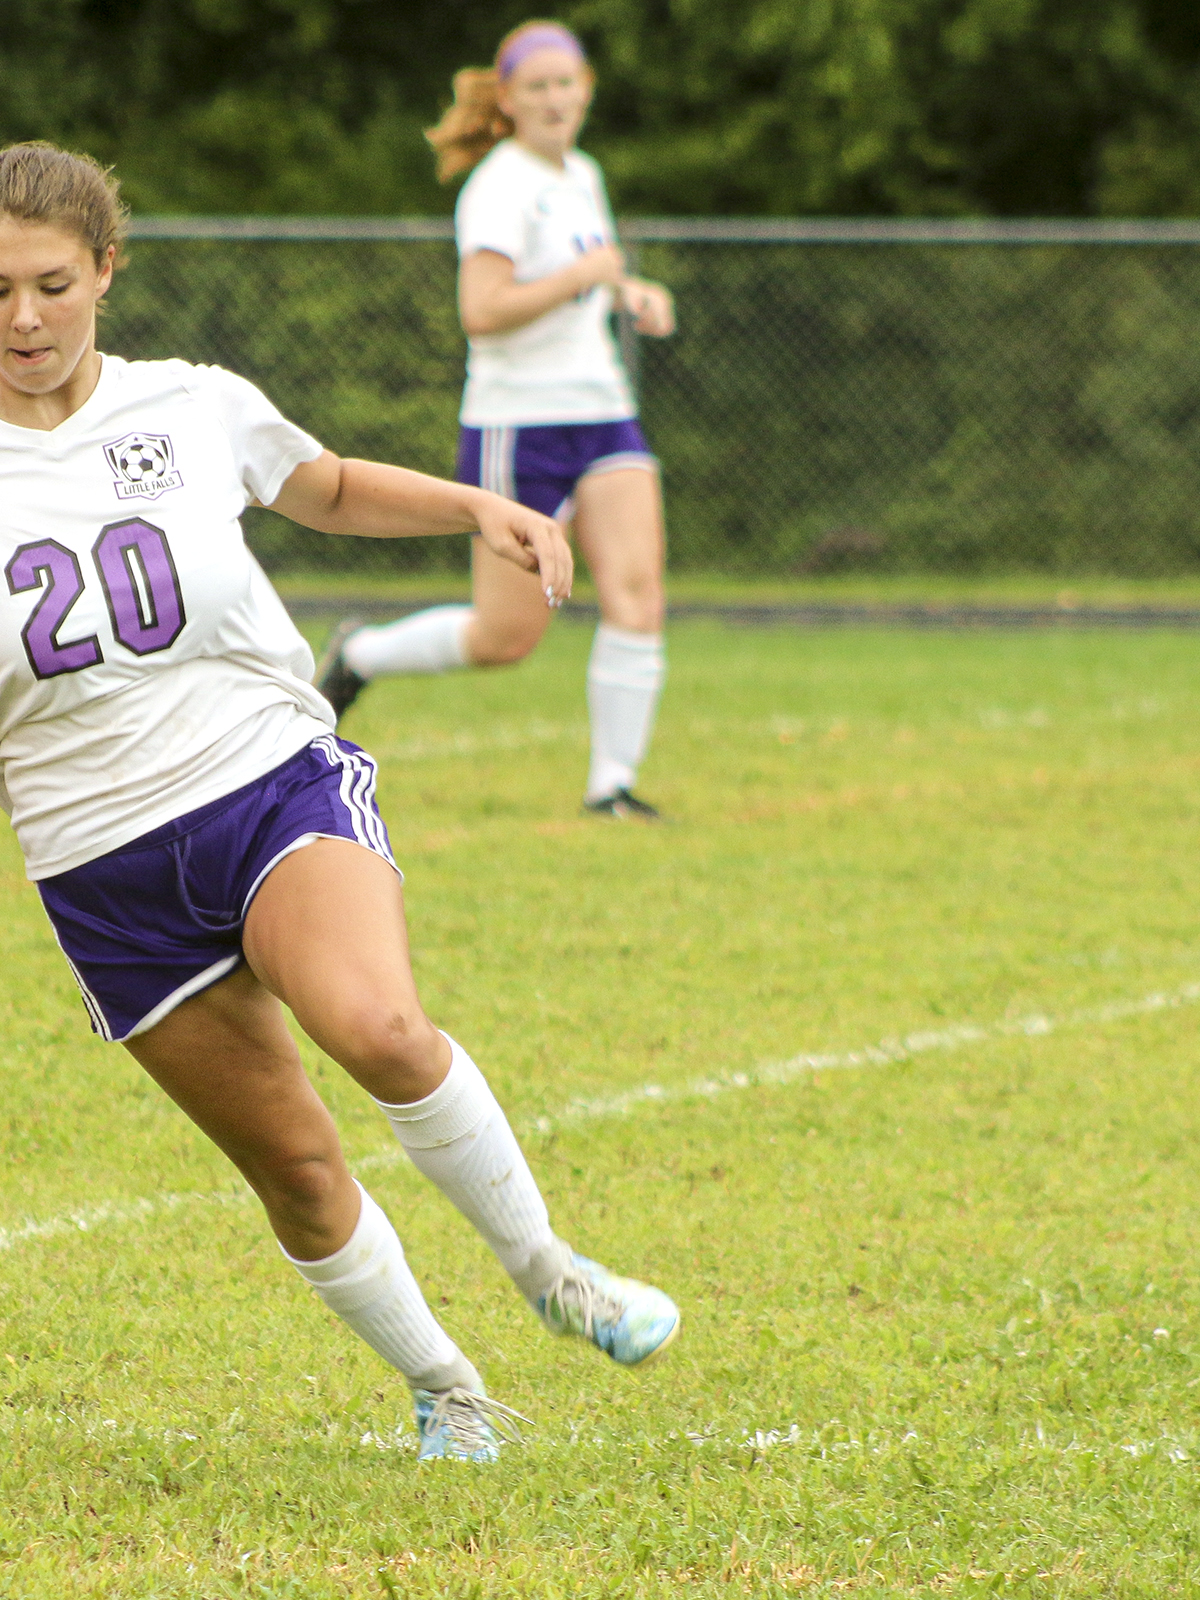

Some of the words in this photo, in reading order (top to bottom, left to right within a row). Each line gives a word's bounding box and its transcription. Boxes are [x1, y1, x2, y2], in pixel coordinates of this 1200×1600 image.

[124, 481, 149, 495] LITTLE
[151, 477, 175, 490] FALLS
[4, 516, 187, 681] 20
